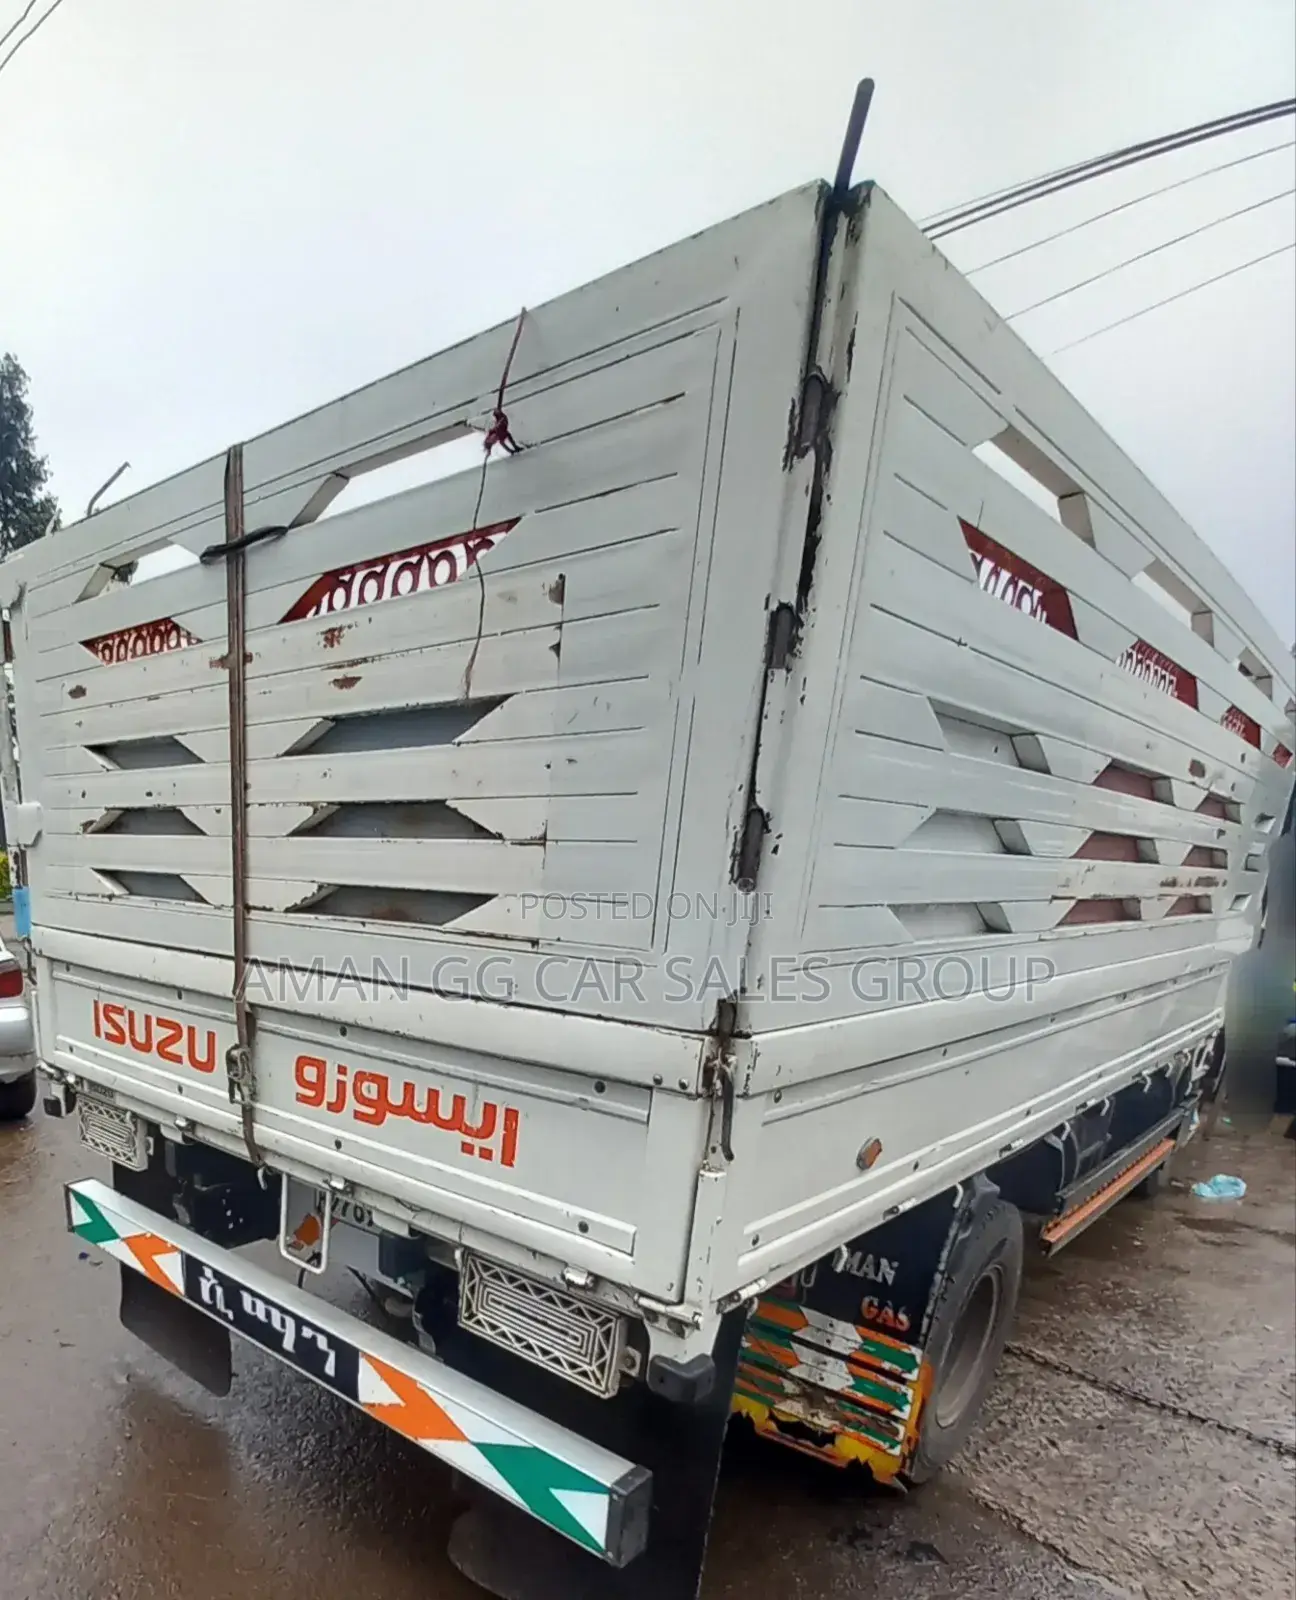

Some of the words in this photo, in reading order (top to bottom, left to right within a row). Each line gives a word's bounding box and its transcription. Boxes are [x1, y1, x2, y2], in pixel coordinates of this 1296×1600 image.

[94, 999, 216, 1074] ISUZU
[295, 1055, 519, 1167] ايسوزو
[861, 1295, 912, 1332] GAS
